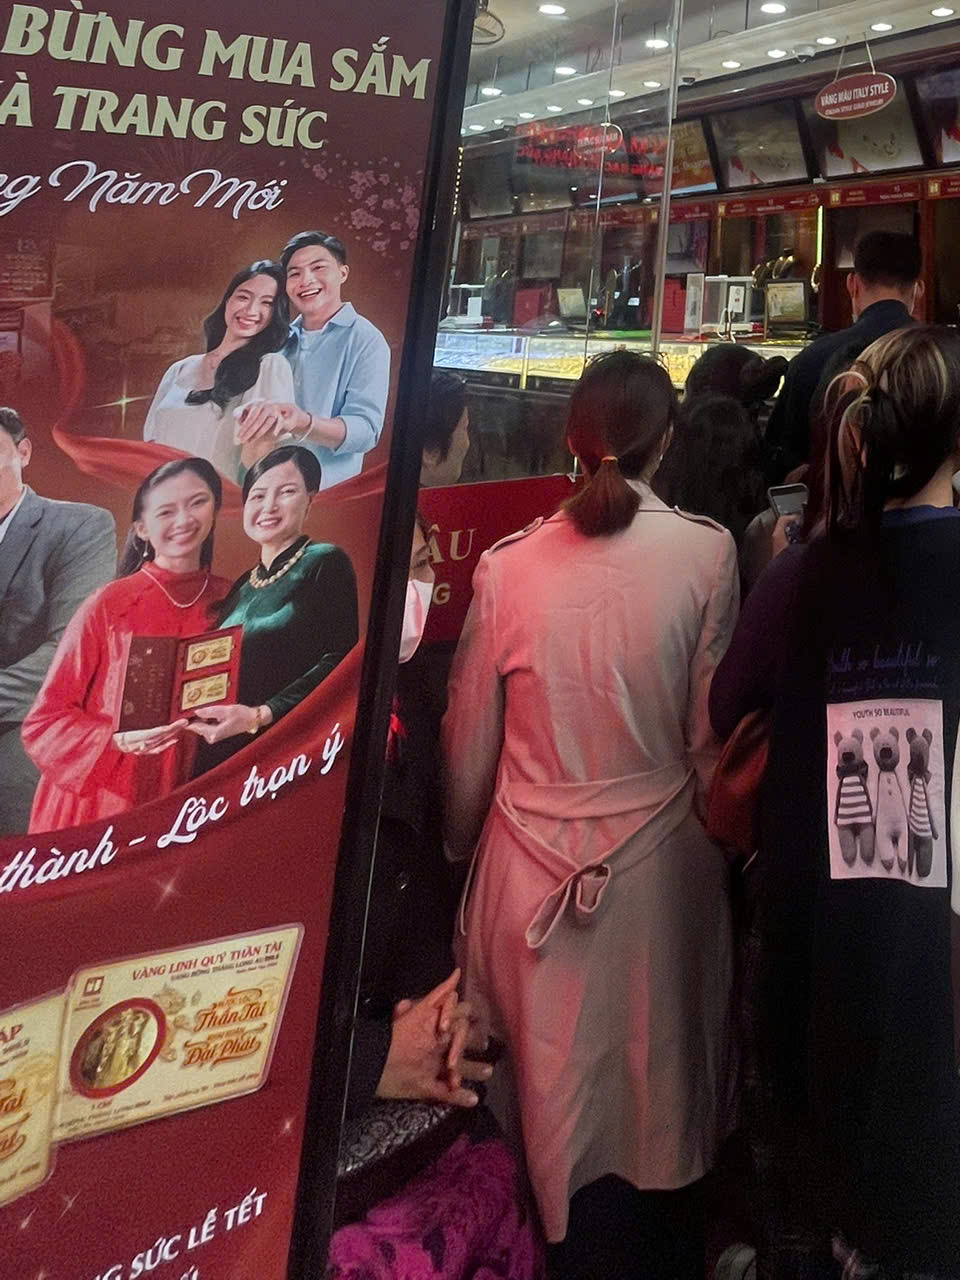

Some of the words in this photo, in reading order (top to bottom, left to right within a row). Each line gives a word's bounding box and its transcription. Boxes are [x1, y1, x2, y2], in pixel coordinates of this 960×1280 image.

[2, 0, 185, 71] BỪNG
[198, 29, 316, 88] MUA
[330, 36, 432, 100] SẮM
[0, 71, 33, 128] À
[52, 86, 227, 142] TRANG
[239, 100, 328, 149] SỨC
[852, 85, 869, 100] ITALY
[869, 81, 889, 97] STYLE
[48, 160, 182, 212] Năm
[180, 169, 288, 220] Mới
[427, 523, 477, 564] ÂU
[874, 708, 883, 718] SO
[0, 825, 115, 893] thành
[157, 794, 229, 848] Lộc
[240, 756, 312, 808] trọn
[321, 722, 345, 775] ý
[132, 965, 166, 981] VÀNG
[168, 958, 199, 974] LINH
[129, 1237, 182, 1279] SỨC
[187, 1207, 218, 1249] LỄ
[223, 1187, 268, 1231] TẾT
